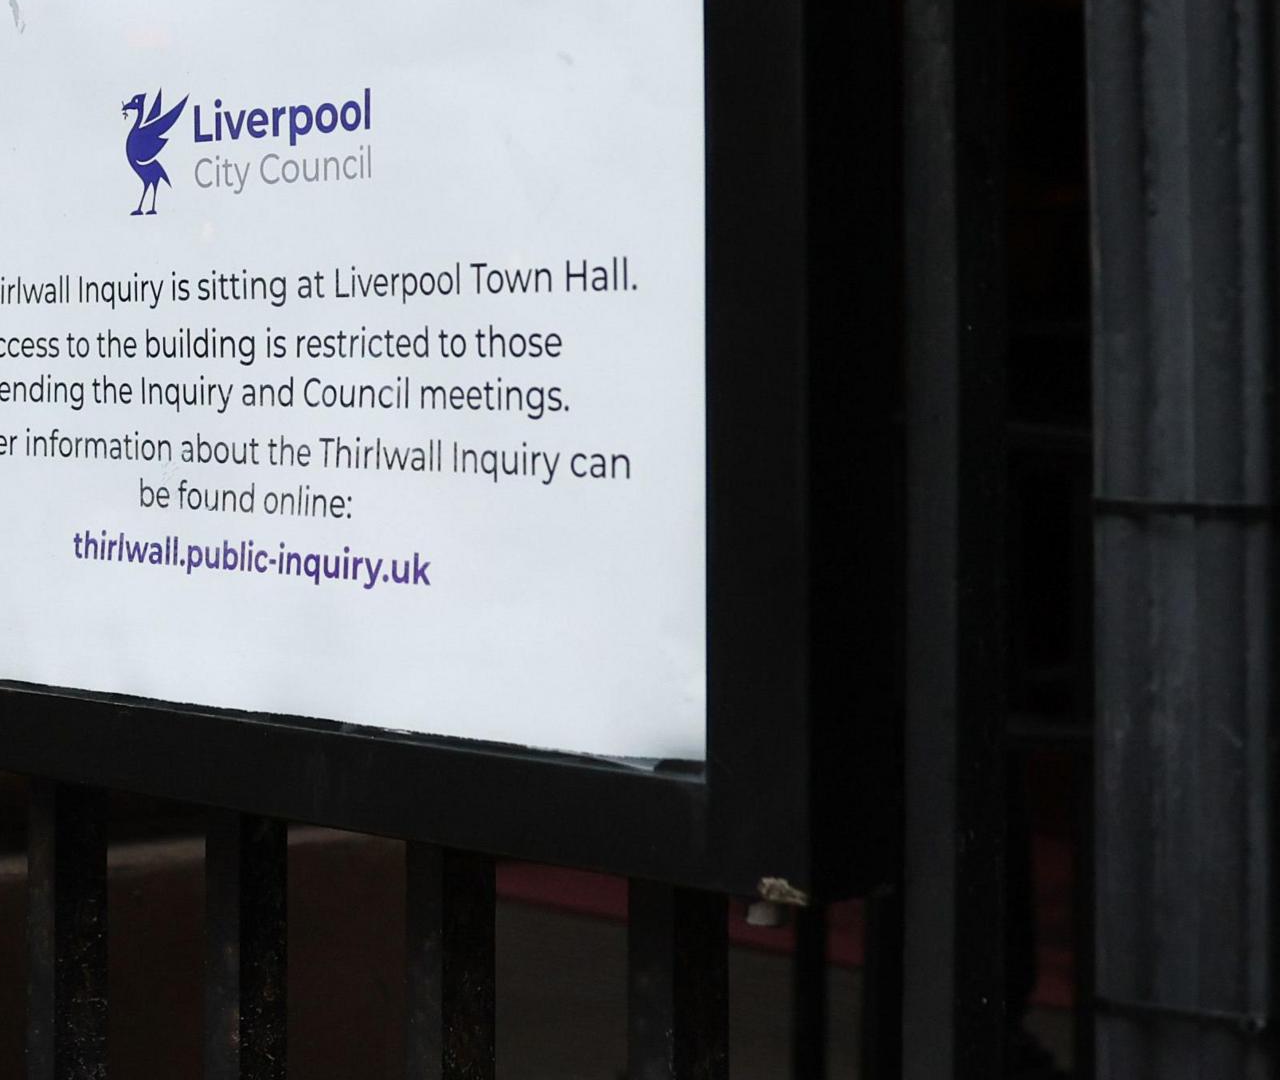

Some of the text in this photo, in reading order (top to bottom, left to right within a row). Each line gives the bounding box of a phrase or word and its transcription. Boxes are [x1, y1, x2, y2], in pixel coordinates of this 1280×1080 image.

[193, 87, 372, 147] Liverpool
[194, 144, 372, 195] City Council
[78, 271, 165, 311] Inquiry
[171, 270, 191, 302] is
[197, 268, 287, 308] sitting
[297, 270, 326, 300] at
[335, 261, 461, 305] Liverpool
[469, 261, 553, 295] Town
[565, 255, 638, 293] Hall.
[65, 332, 91, 359] to
[95, 328, 138, 359] the
[145, 326, 256, 367] building
[266, 326, 287, 359] is
[296, 324, 430, 359] restricted
[437, 328, 467, 359] to
[474, 323, 563, 359] those
[91, 373, 133, 405] the
[141, 374, 234, 415] Inquiry
[241, 375, 295, 408] and
[303, 375, 410, 410] Council
[420, 376, 570, 421] meetings.
[25, 426, 173, 463] information
[180, 431, 260, 466] about
[267, 434, 312, 468] the
[318, 435, 442, 473] Thirlwall
[453, 440, 561, 486] Inquiry
[569, 452, 631, 480] can
[139, 476, 353, 520] be found online:
[72, 529, 432, 591] thirlwall.public-inquiry.uk
